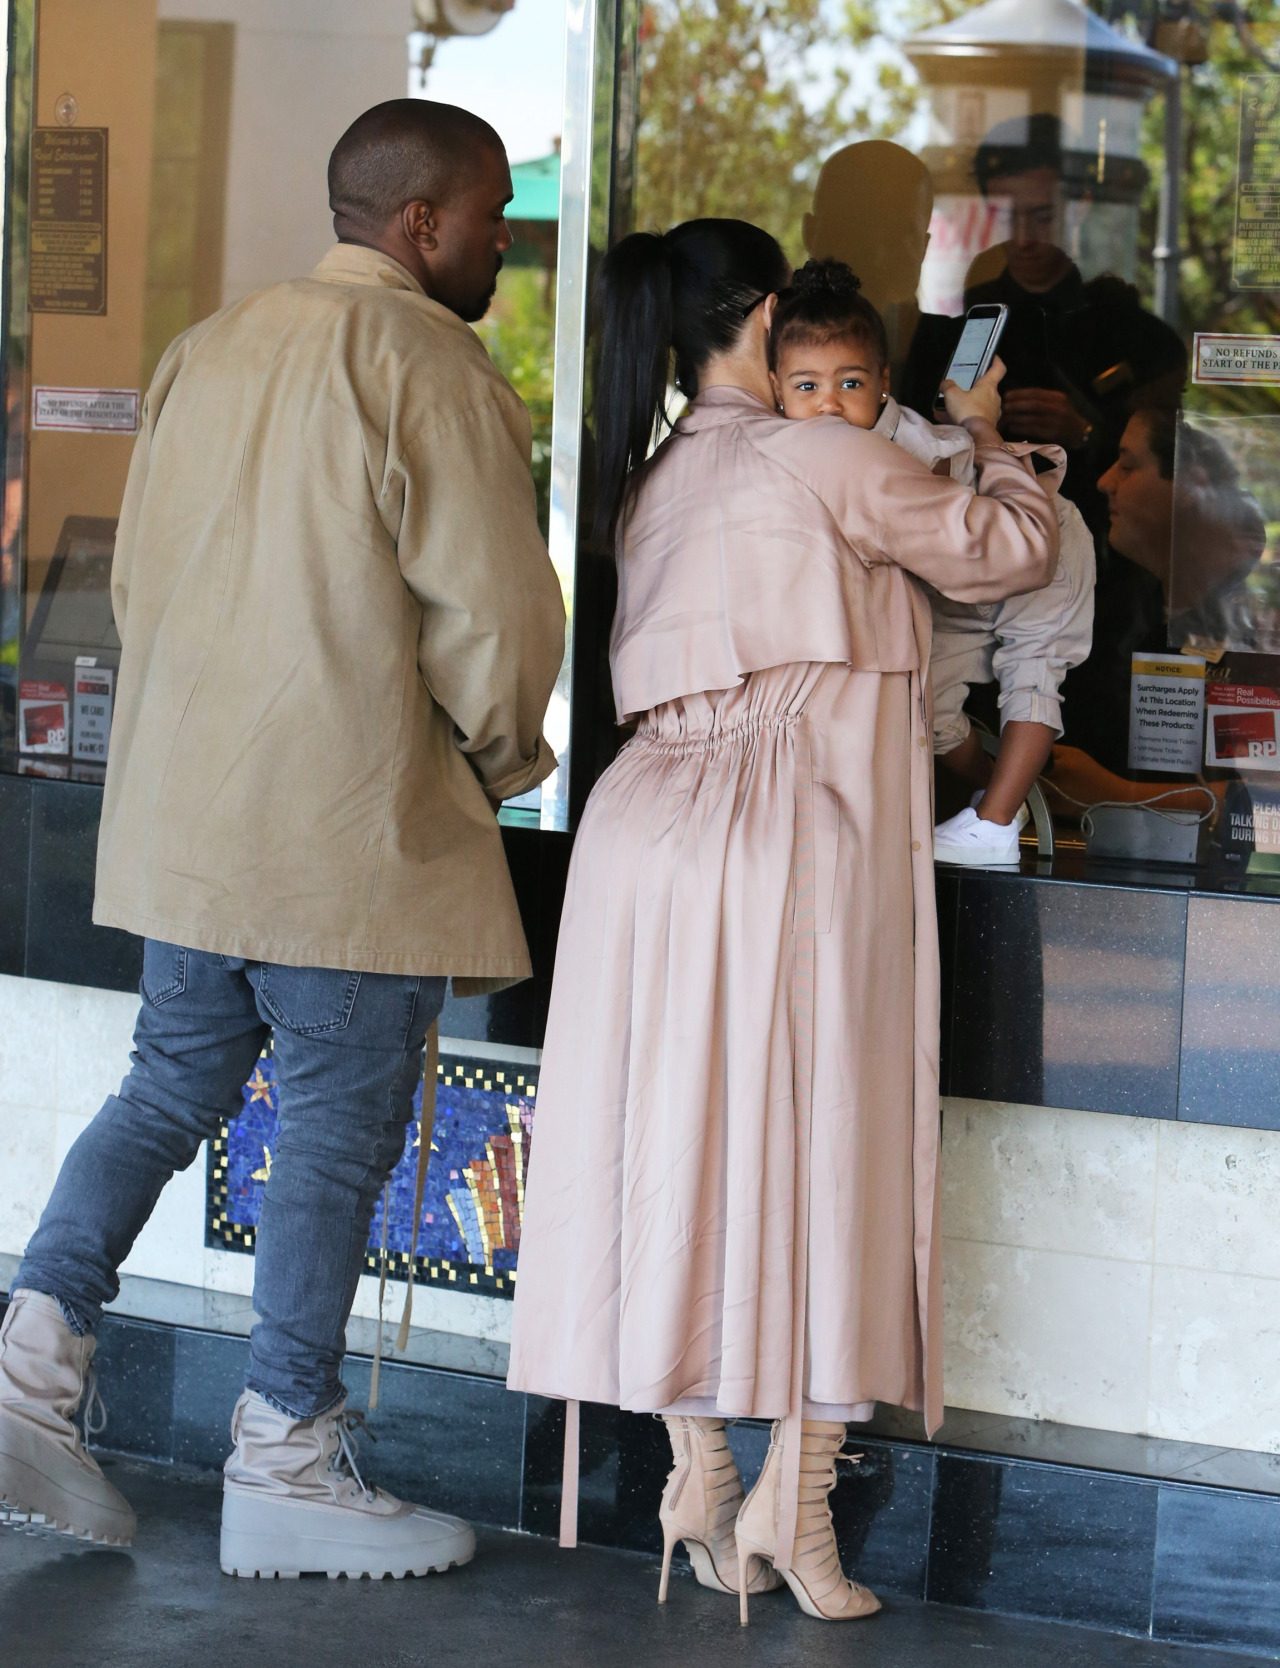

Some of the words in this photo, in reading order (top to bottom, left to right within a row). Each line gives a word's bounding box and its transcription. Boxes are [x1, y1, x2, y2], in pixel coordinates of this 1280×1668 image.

[1216, 348, 1230, 357] NO
[1233, 348, 1278, 359] REFUNDS
[1202, 359, 1233, 368] START
[1235, 360, 1248, 369] OF
[1251, 360, 1270, 370] THE
[89, 400, 110, 409] AFTER
[112, 401, 125, 410] THE
[70, 409, 83, 417] THE
[84, 410, 133, 420] PRESENTATION
[1137, 684, 1176, 695] Surcharges
[1177, 686, 1199, 696] Apply
[1237, 687, 1254, 698] Real
[1165, 698, 1196, 706] Location
[1236, 695, 1280, 706] Possibilities
[1135, 707, 1156, 715] When
[1158, 709, 1199, 720] Redeeming
[1139, 719, 1160, 728] These
[1161, 721, 1195, 730] Products:
[1230, 813, 1269, 831] TALKING
[1231, 827, 1269, 844] DURING
